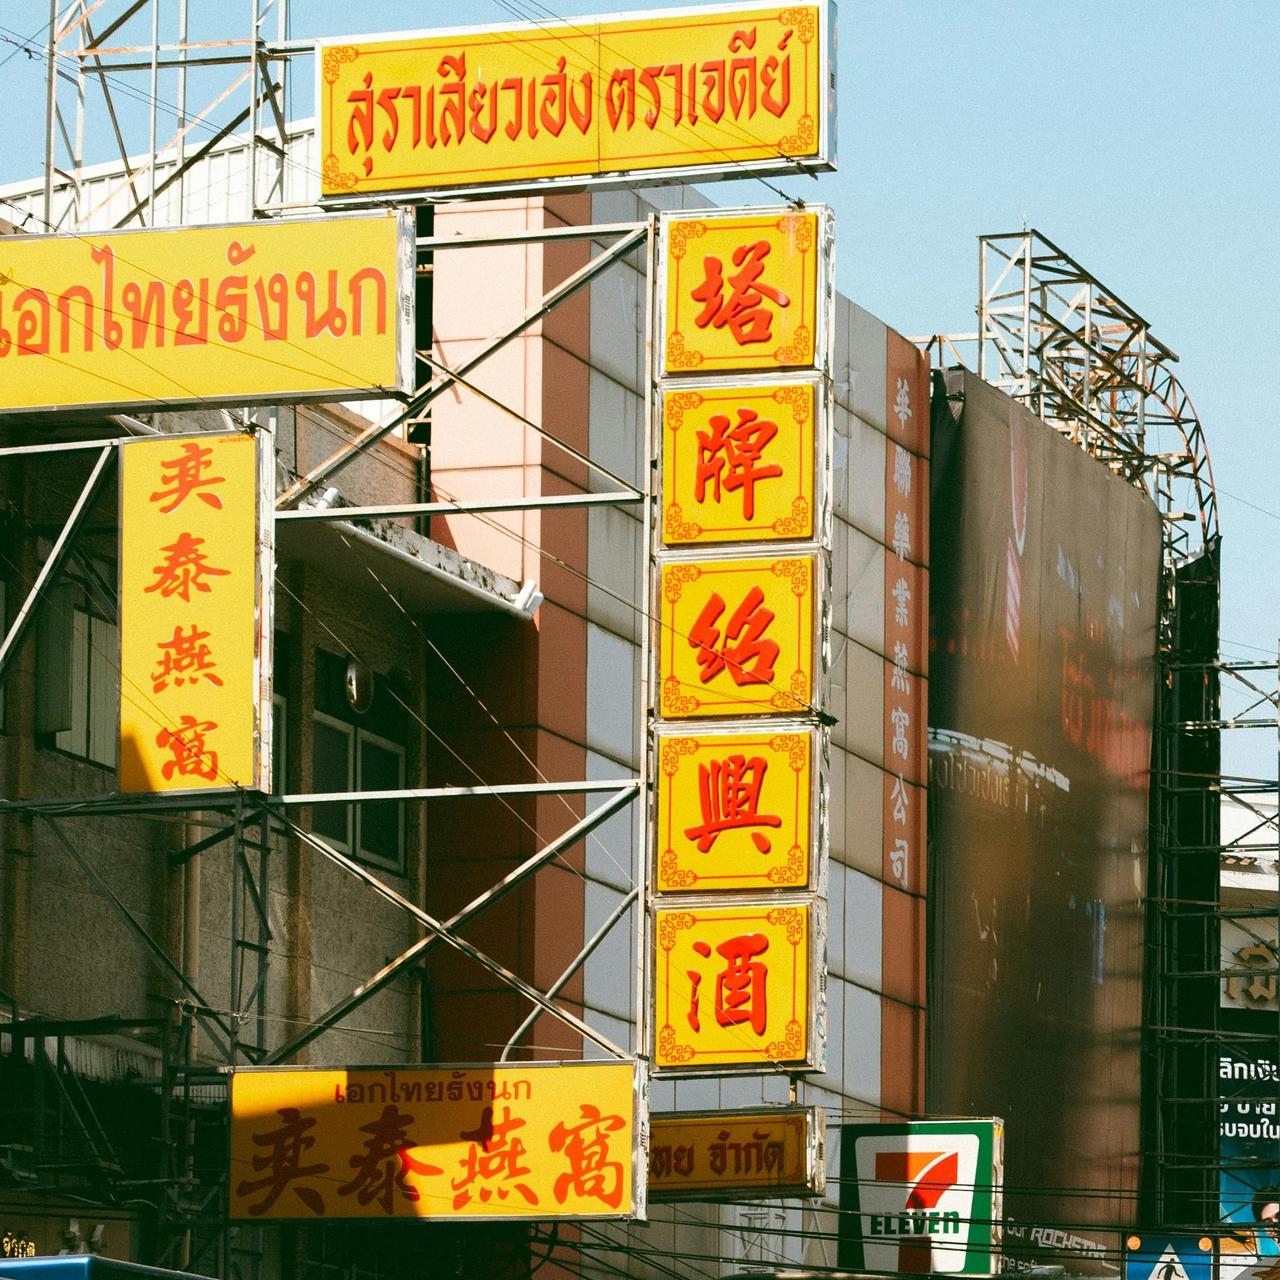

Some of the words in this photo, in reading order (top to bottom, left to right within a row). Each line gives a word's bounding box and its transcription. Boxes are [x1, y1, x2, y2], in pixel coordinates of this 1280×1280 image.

[334, 1073, 532, 1106] เอกไทยรังนก
[708, 1129, 785, 1178] จำกัด
[875, 1152, 959, 1273] 7
